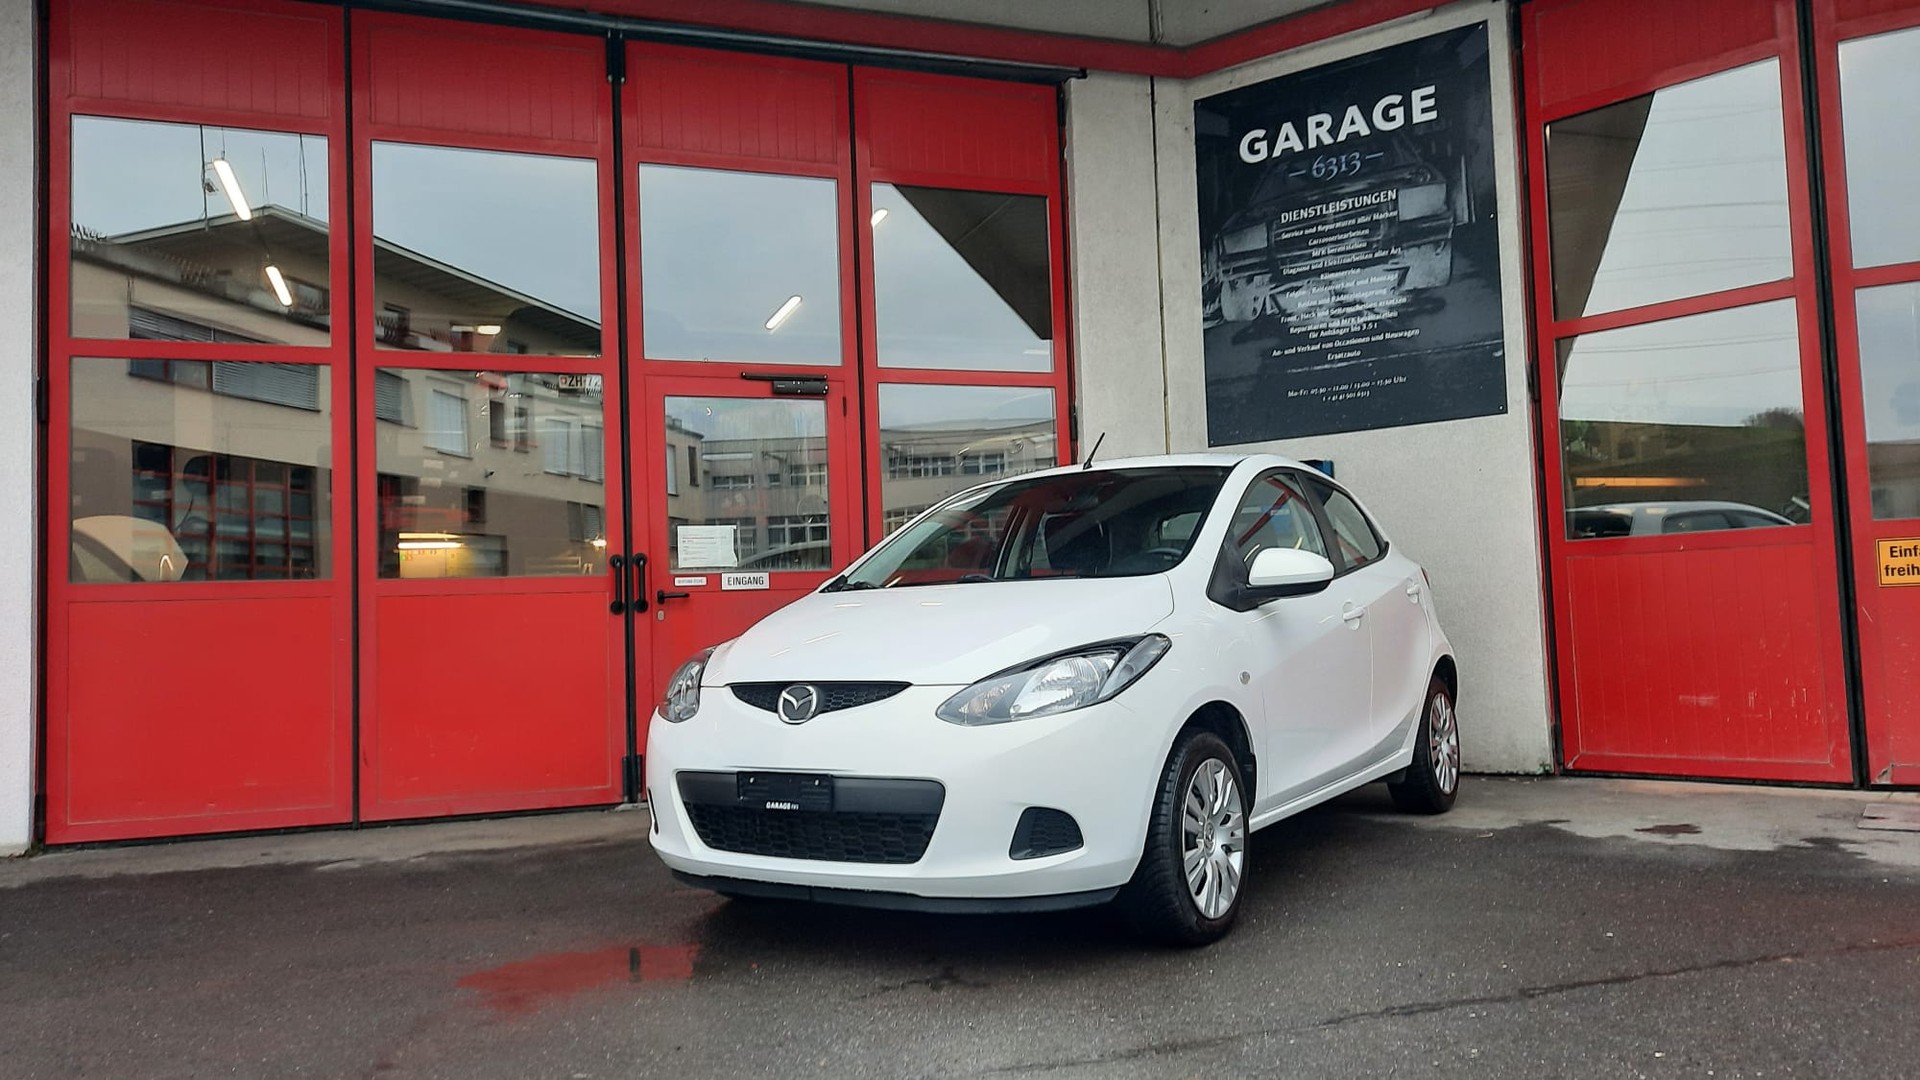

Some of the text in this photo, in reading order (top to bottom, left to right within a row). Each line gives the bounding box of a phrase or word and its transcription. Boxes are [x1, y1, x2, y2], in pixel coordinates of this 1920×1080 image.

[1239, 84, 1438, 163] GARAGE
[1312, 152, 1362, 181] 6313
[1281, 188, 1397, 223] DIENSTLEISTUNGEN
[1281, 210, 1398, 240] Service und Reparaturen aller Marken
[1311, 261, 1323, 270] und
[1374, 249, 1389, 258] aller
[1390, 246, 1401, 255] Art
[1290, 321, 1327, 334] Reparaturen
[1328, 319, 1340, 328] und
[1309, 330, 1319, 339] für
[1320, 326, 1350, 337] Anhänger
[1351, 324, 1361, 332] bis
[1284, 346, 1296, 355] und
[1297, 342, 1321, 352] Verkauf
[1322, 341, 1333, 349] von
[1334, 336, 1370, 348] Occasionen
[1371, 332, 1384, 341] und
[1385, 328, 1419, 340] Neuwagen
[1327, 350, 1361, 361] Ersatzauto
[1393, 376, 1406, 384] Uhr
[1889, 545, 1920, 558] Einf
[727, 576, 764, 586] EINGANG
[765, 801, 791, 810] GARAGE
